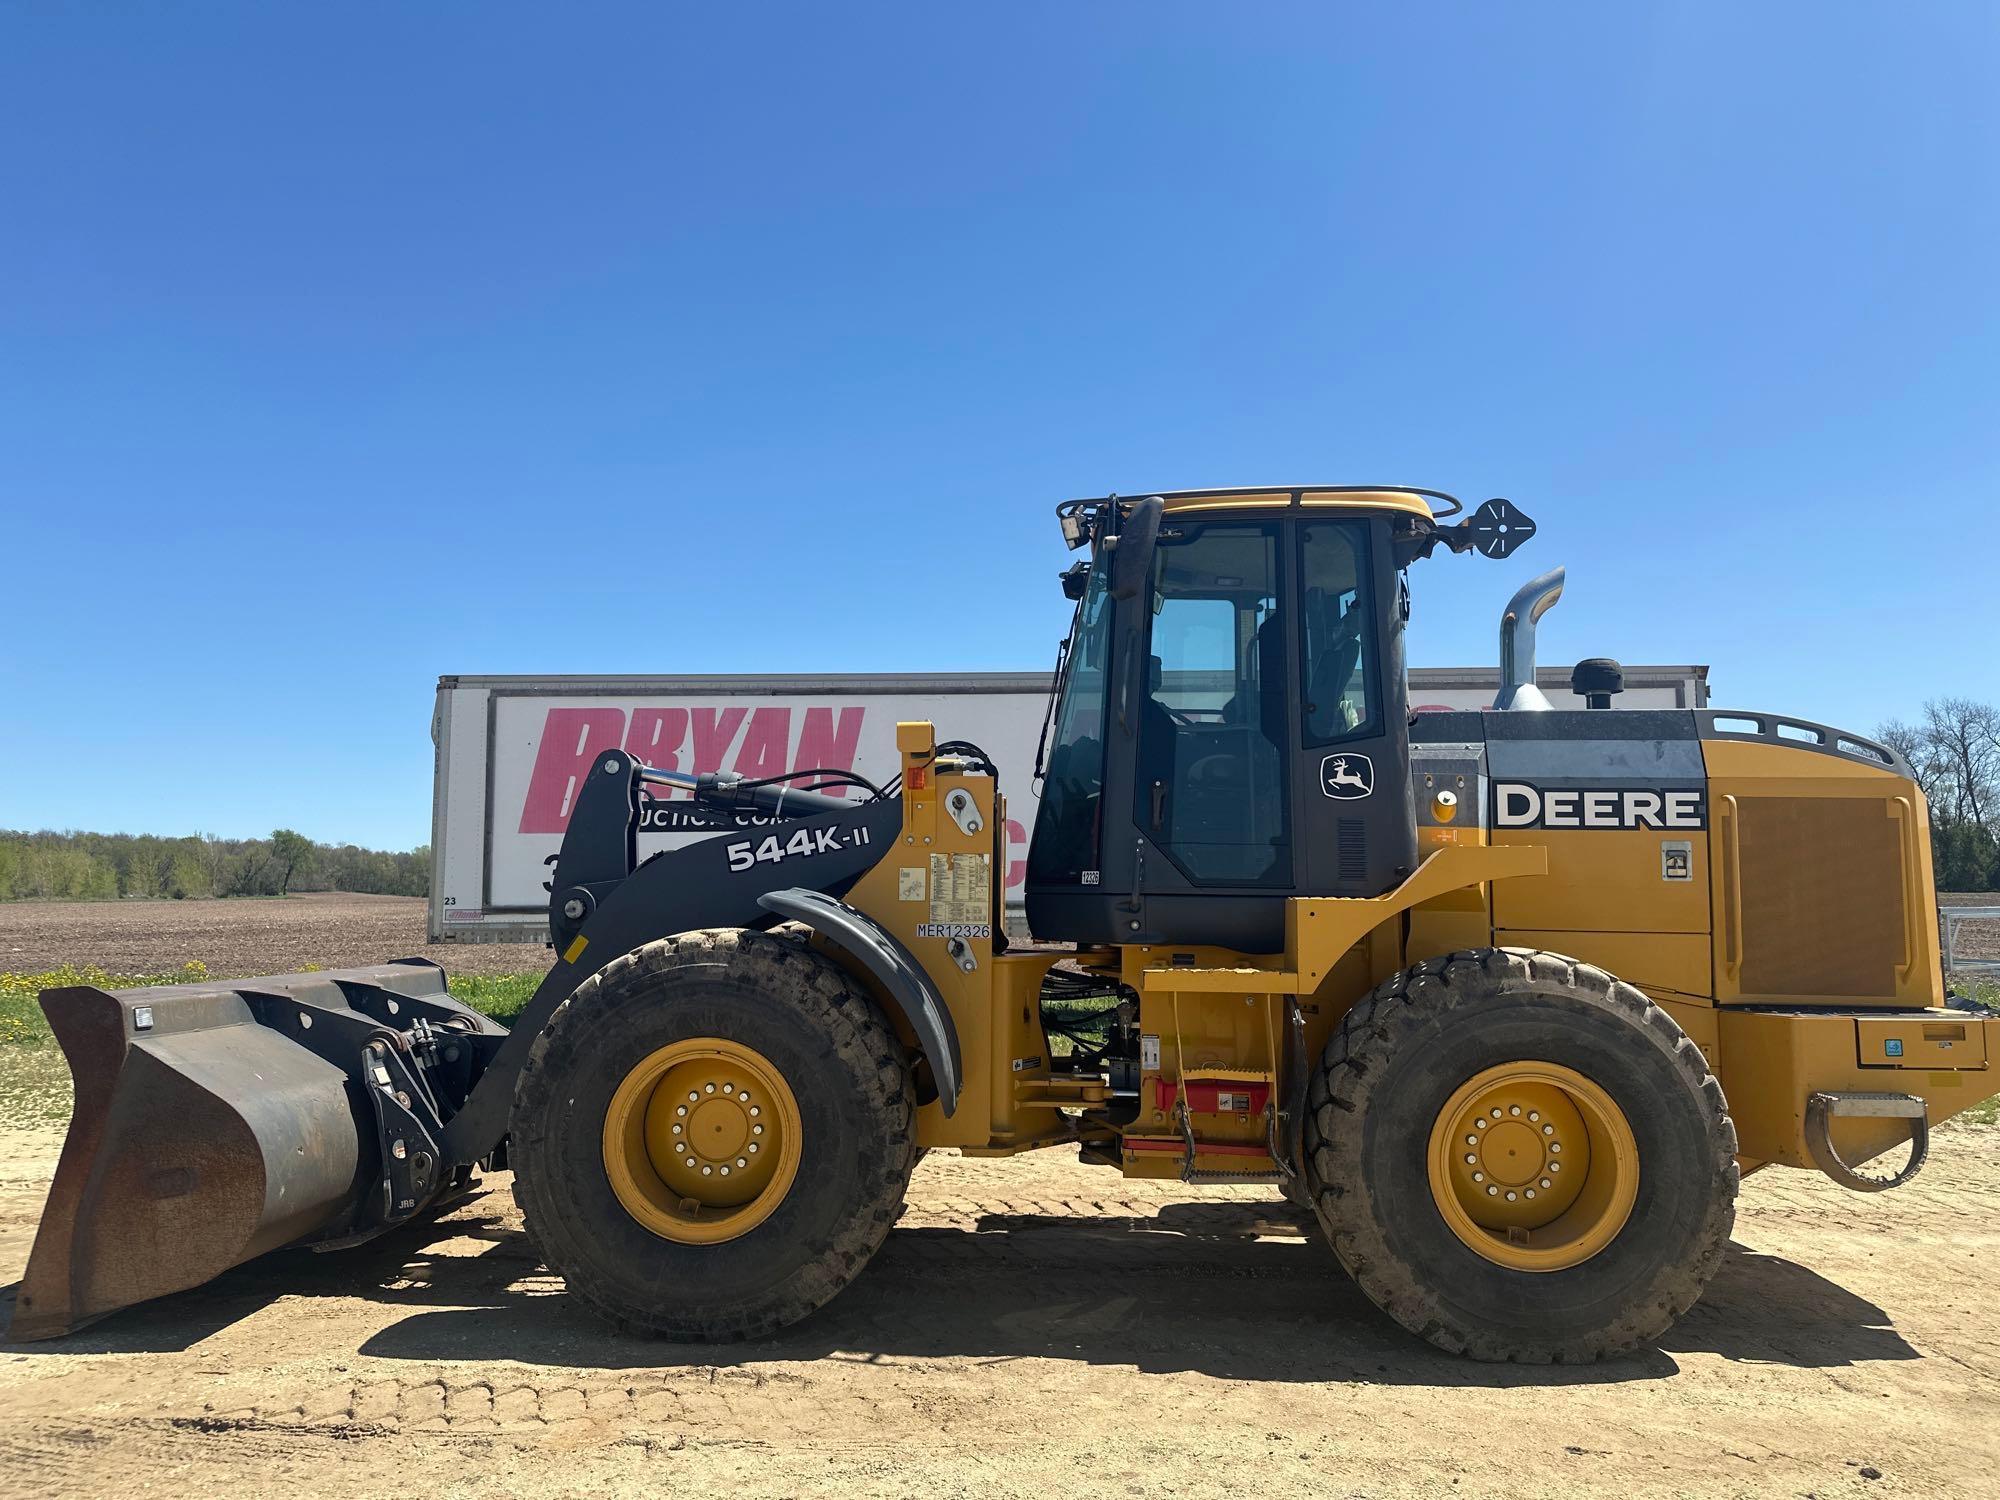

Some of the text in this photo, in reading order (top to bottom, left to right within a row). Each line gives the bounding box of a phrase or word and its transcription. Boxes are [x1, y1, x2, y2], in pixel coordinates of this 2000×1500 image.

[518, 706, 866, 834] BRYAN
[1496, 784, 1701, 827] DEERE
[727, 826, 870, 872] 544K-II
[1083, 871, 1099, 883] 12326
[444, 896, 456, 905] 23
[918, 924, 990, 938] MER12326
[398, 1198, 415, 1209] JRB
